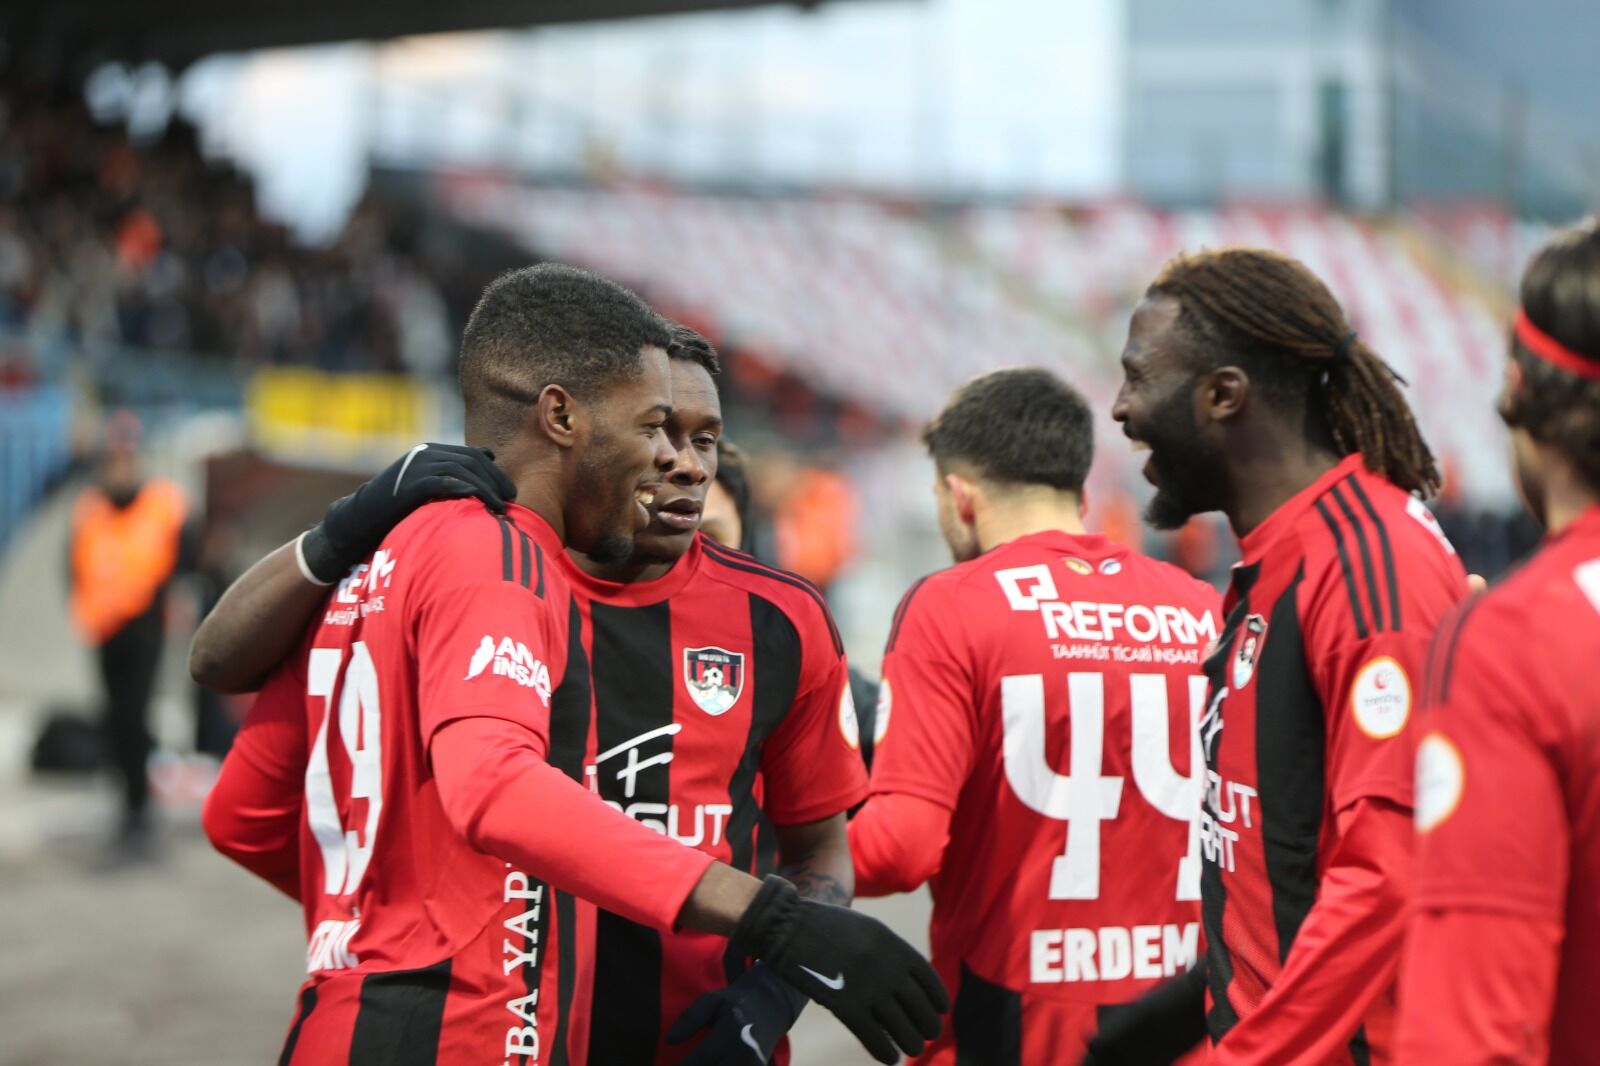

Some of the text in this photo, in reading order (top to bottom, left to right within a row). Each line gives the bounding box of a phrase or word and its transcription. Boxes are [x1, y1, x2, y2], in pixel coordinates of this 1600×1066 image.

[1040, 601, 1217, 644] REFORM
[1000, 671, 1209, 901] 44
[502, 862, 543, 1066] BA YAP
[1030, 922, 1200, 983] ERDEM
